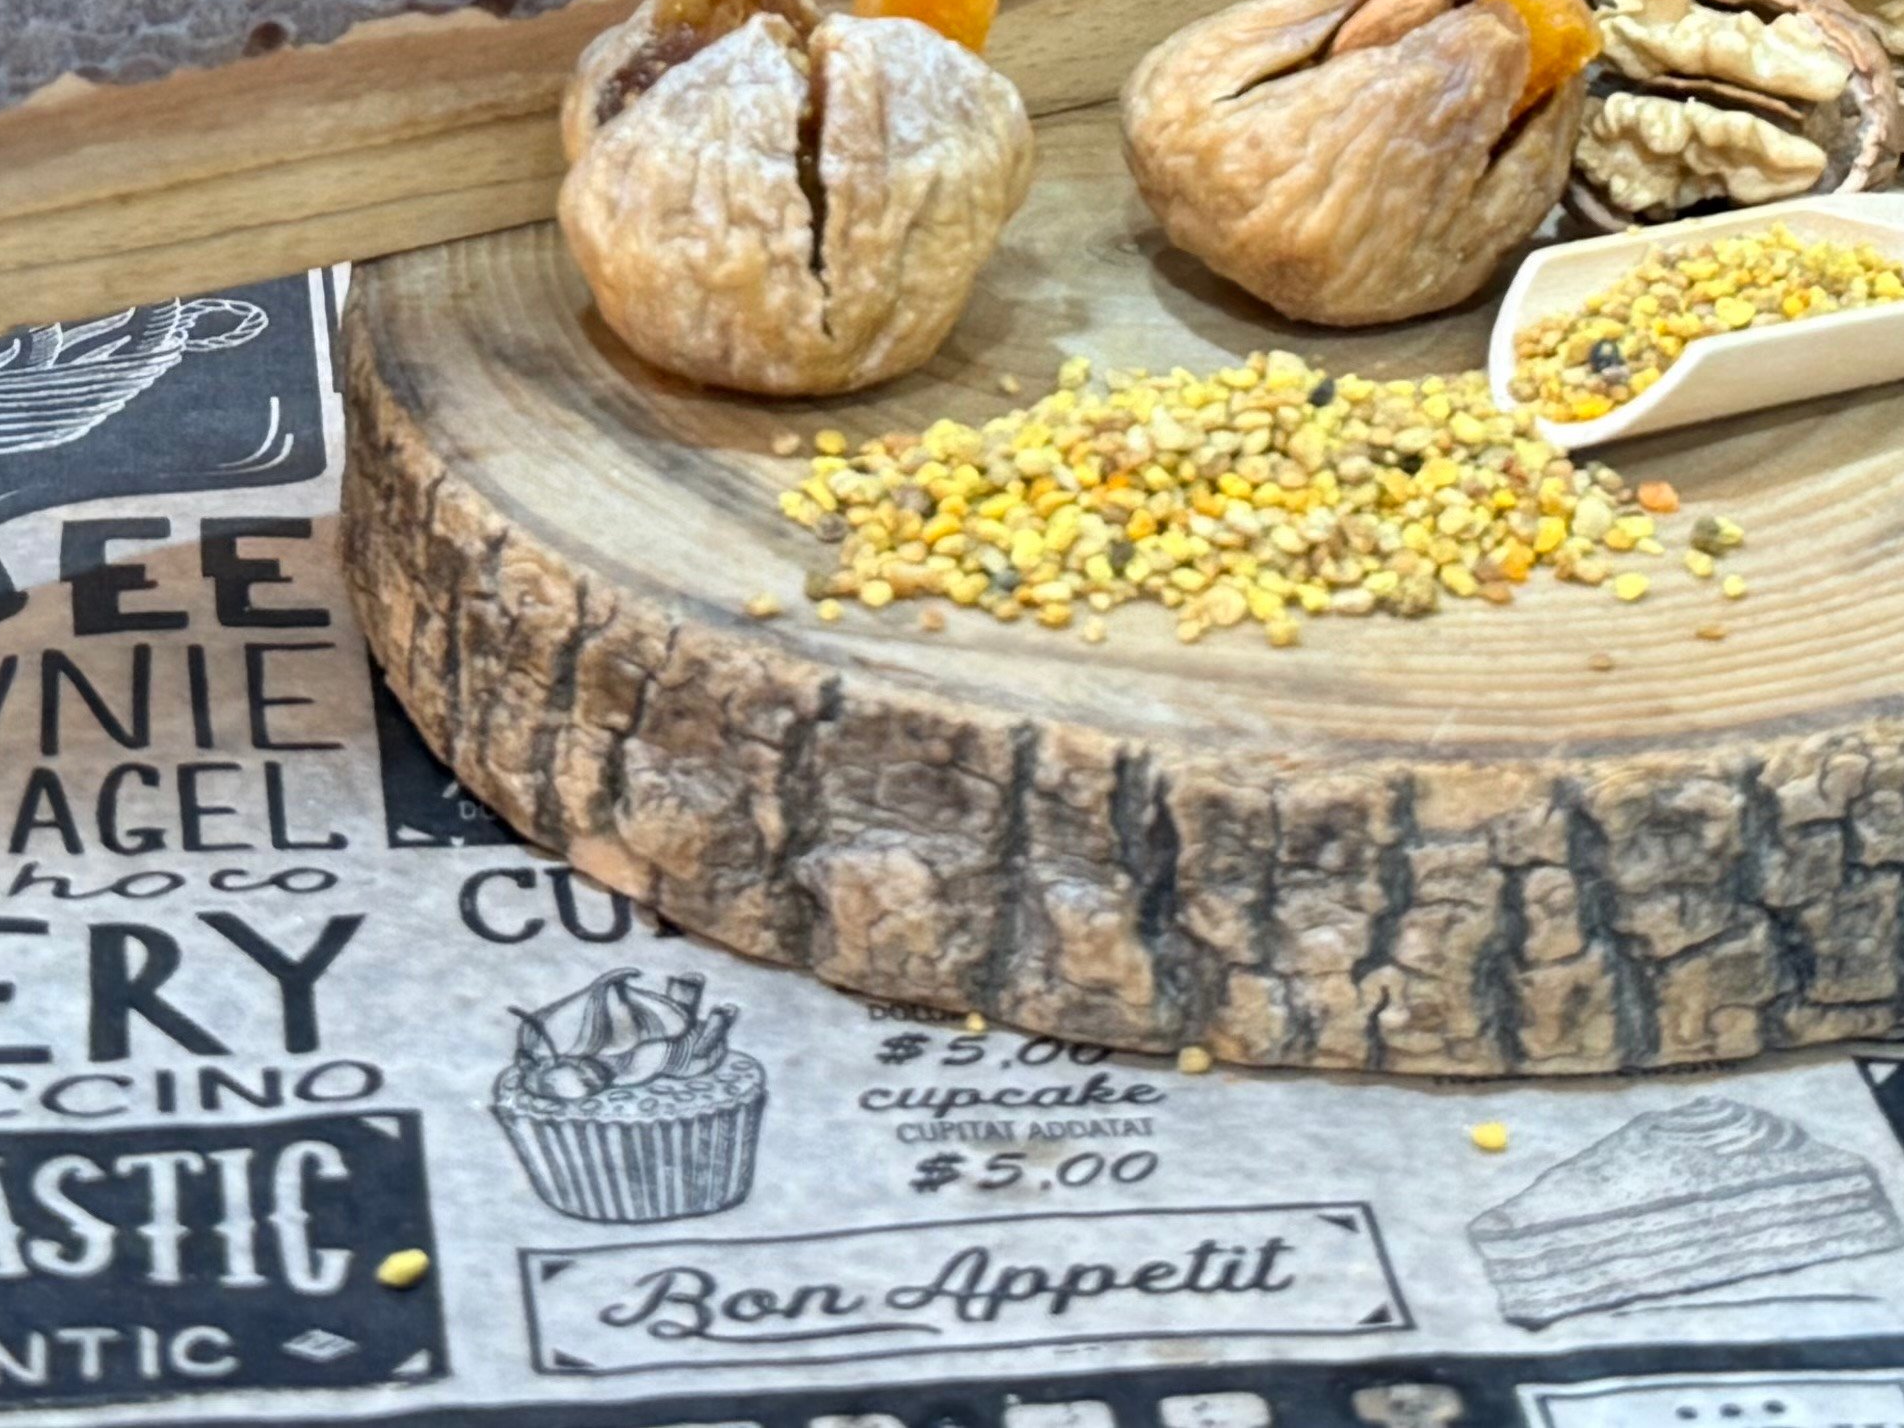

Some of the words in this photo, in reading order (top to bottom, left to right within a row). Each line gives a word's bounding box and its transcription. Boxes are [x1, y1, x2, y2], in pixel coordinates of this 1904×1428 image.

[875, 1032, 1111, 1070] $5.00
[858, 1072, 1168, 1118] cupcake
[896, 1119, 1016, 1143] CUPITAT
[1027, 1116, 1156, 1140] ADDATAT
[909, 1150, 1160, 1194] $5.00
[598, 1266, 864, 1342] Bon
[884, 1235, 1296, 1322] Appetit
